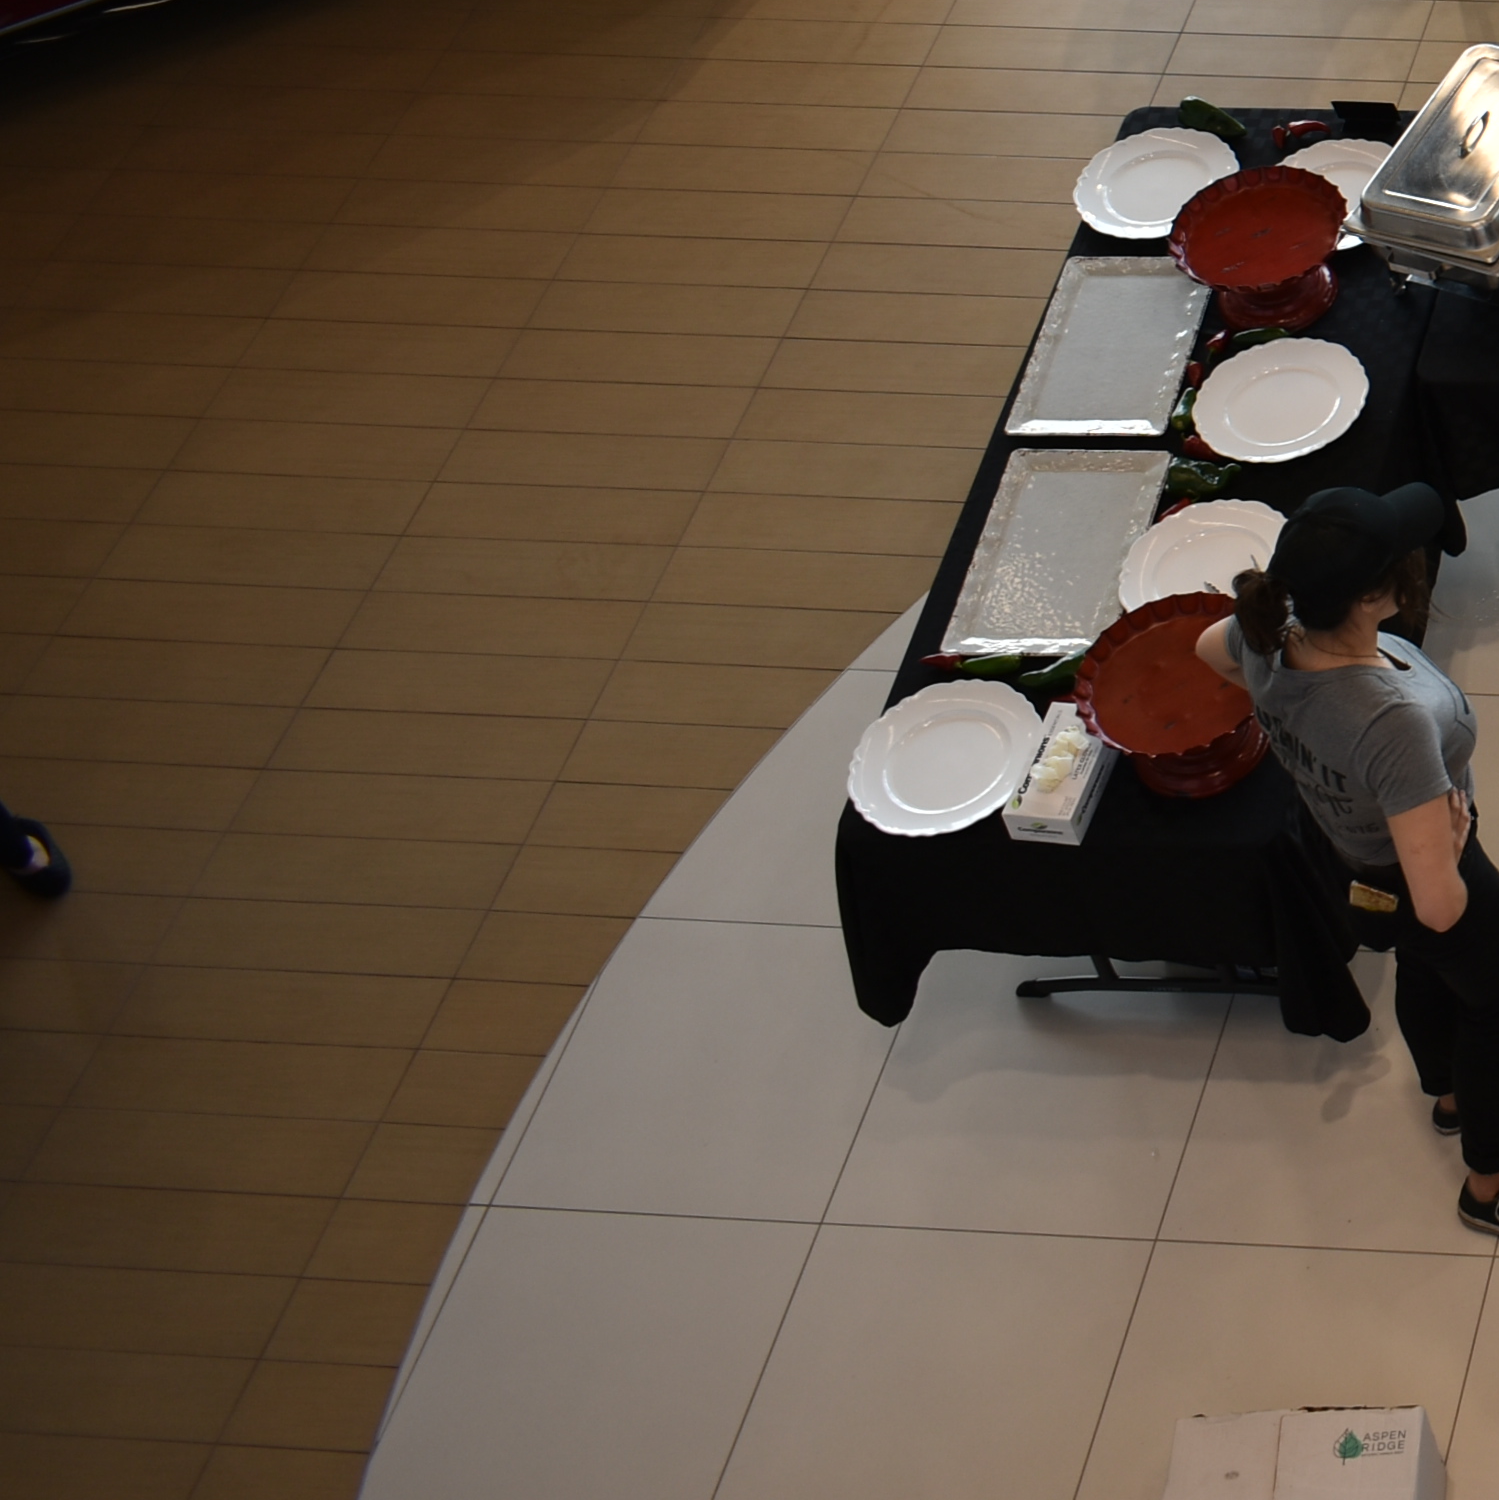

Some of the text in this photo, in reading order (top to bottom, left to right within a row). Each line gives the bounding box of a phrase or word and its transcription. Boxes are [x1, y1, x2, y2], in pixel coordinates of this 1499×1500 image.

[1321, 763, 1347, 794] IT
[1362, 1429, 1407, 1442] ASPEN
[1361, 1440, 1405, 1452] RIDGE
